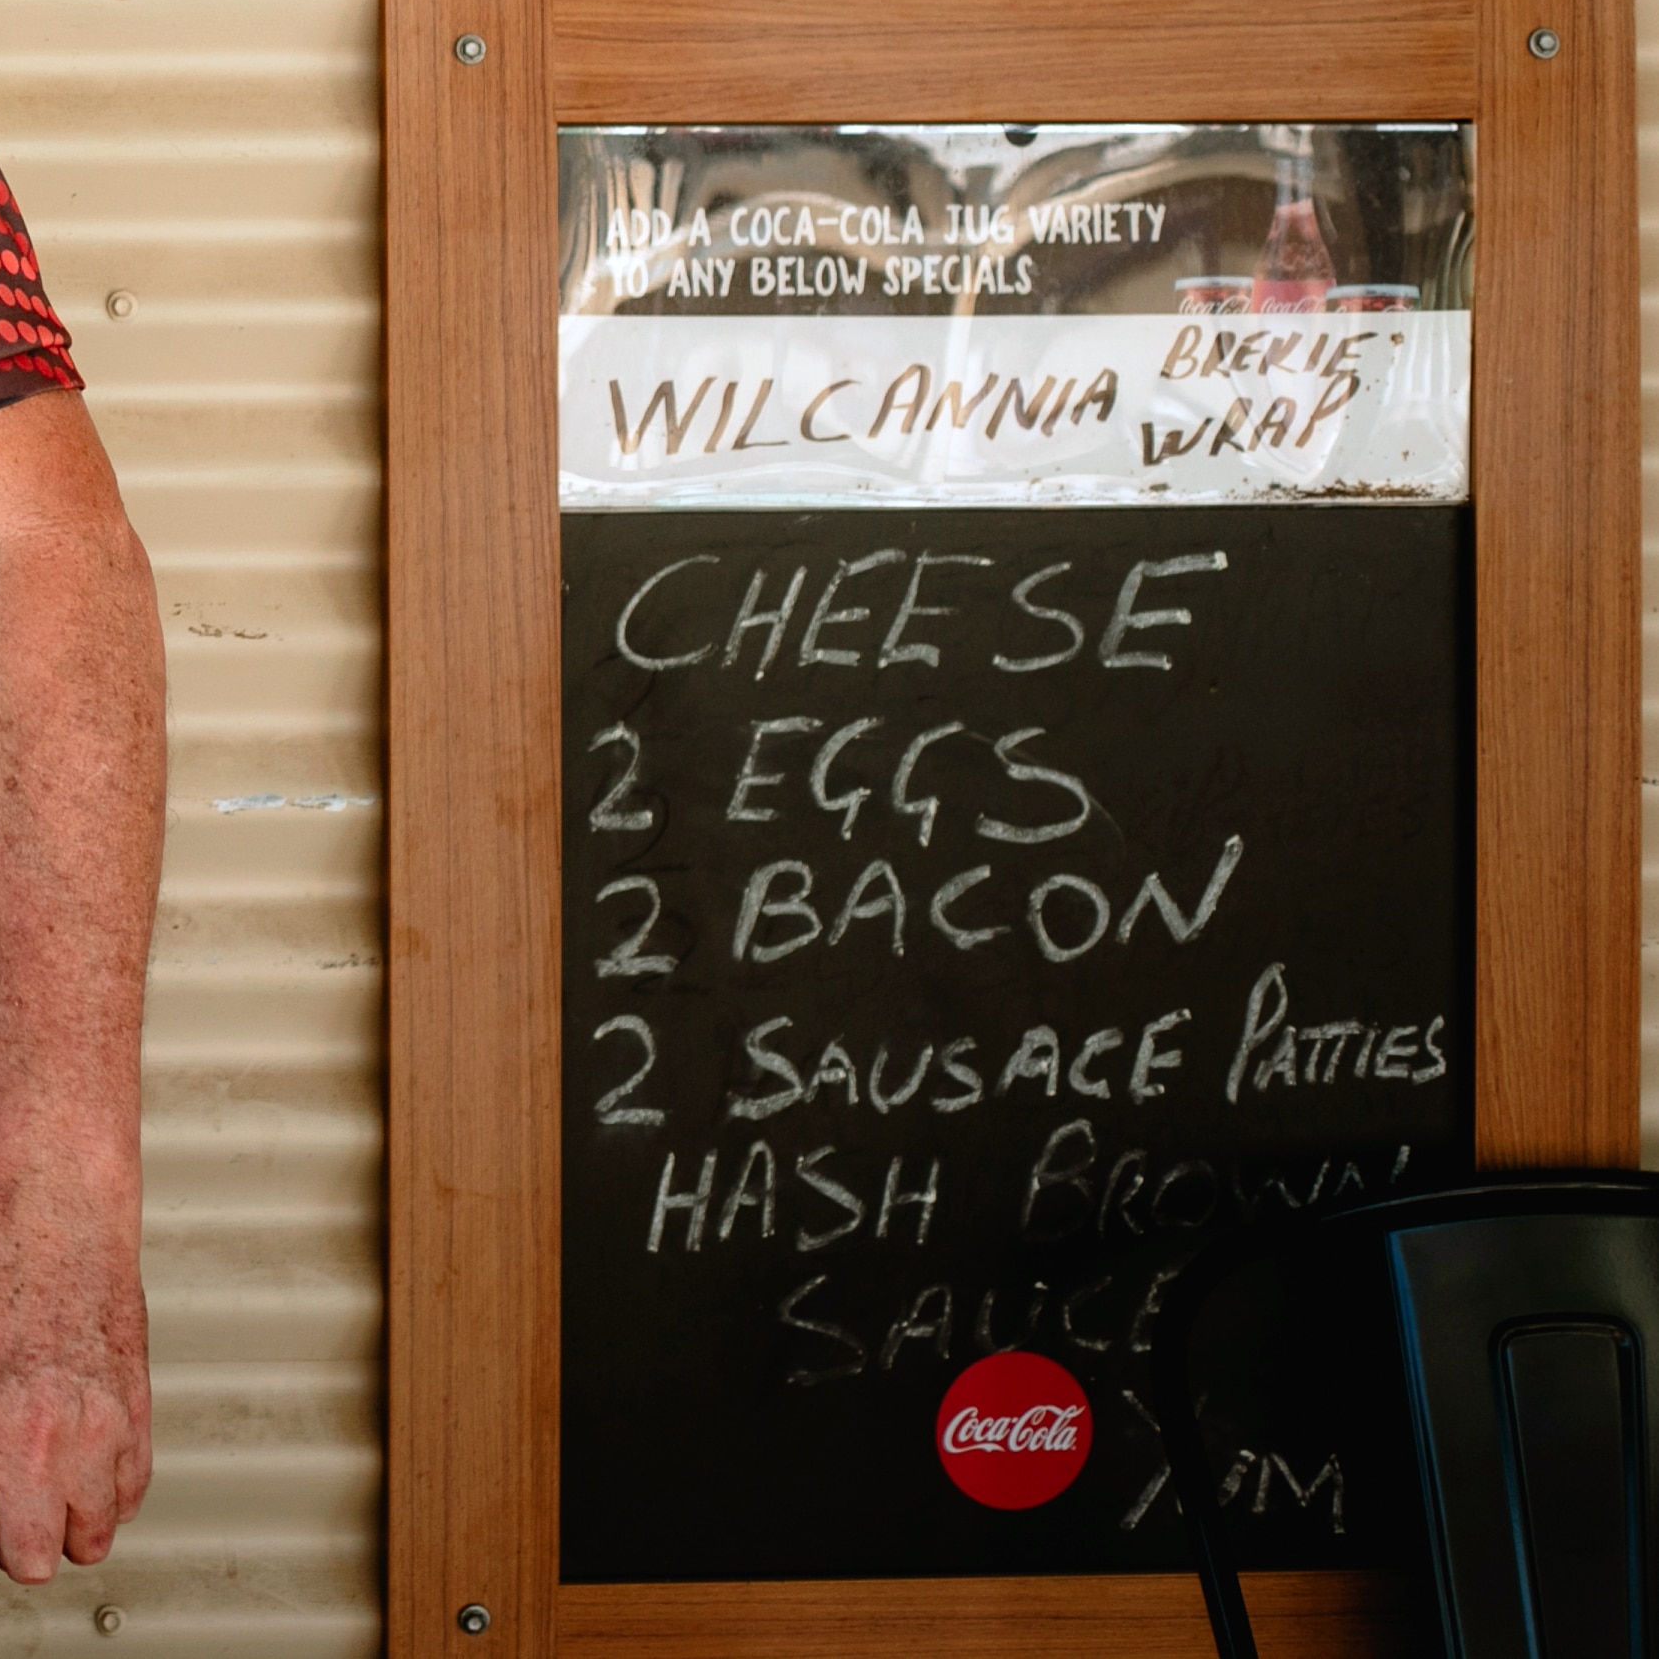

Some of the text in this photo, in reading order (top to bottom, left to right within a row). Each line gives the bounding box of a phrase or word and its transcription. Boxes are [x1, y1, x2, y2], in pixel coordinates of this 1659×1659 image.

[607, 202, 1167, 247] ADD A COCA-COLA JUG VARIETY
[607, 254, 1034, 298] TO ANY BELOW SPECIALS
[608, 361, 1119, 456] WILCANNIA
[1139, 368, 1362, 467] WRAP
[616, 548, 1228, 680] CHEESE
[588, 715, 1092, 848] 2 EGGS
[595, 833, 1244, 977] 2 BACON
[593, 1013, 673, 1126] 2
[1226, 961, 1446, 1104] PATTIES
[647, 1141, 941, 1253] HASH
[942, 1403, 1087, 1455] Coca-Cola
